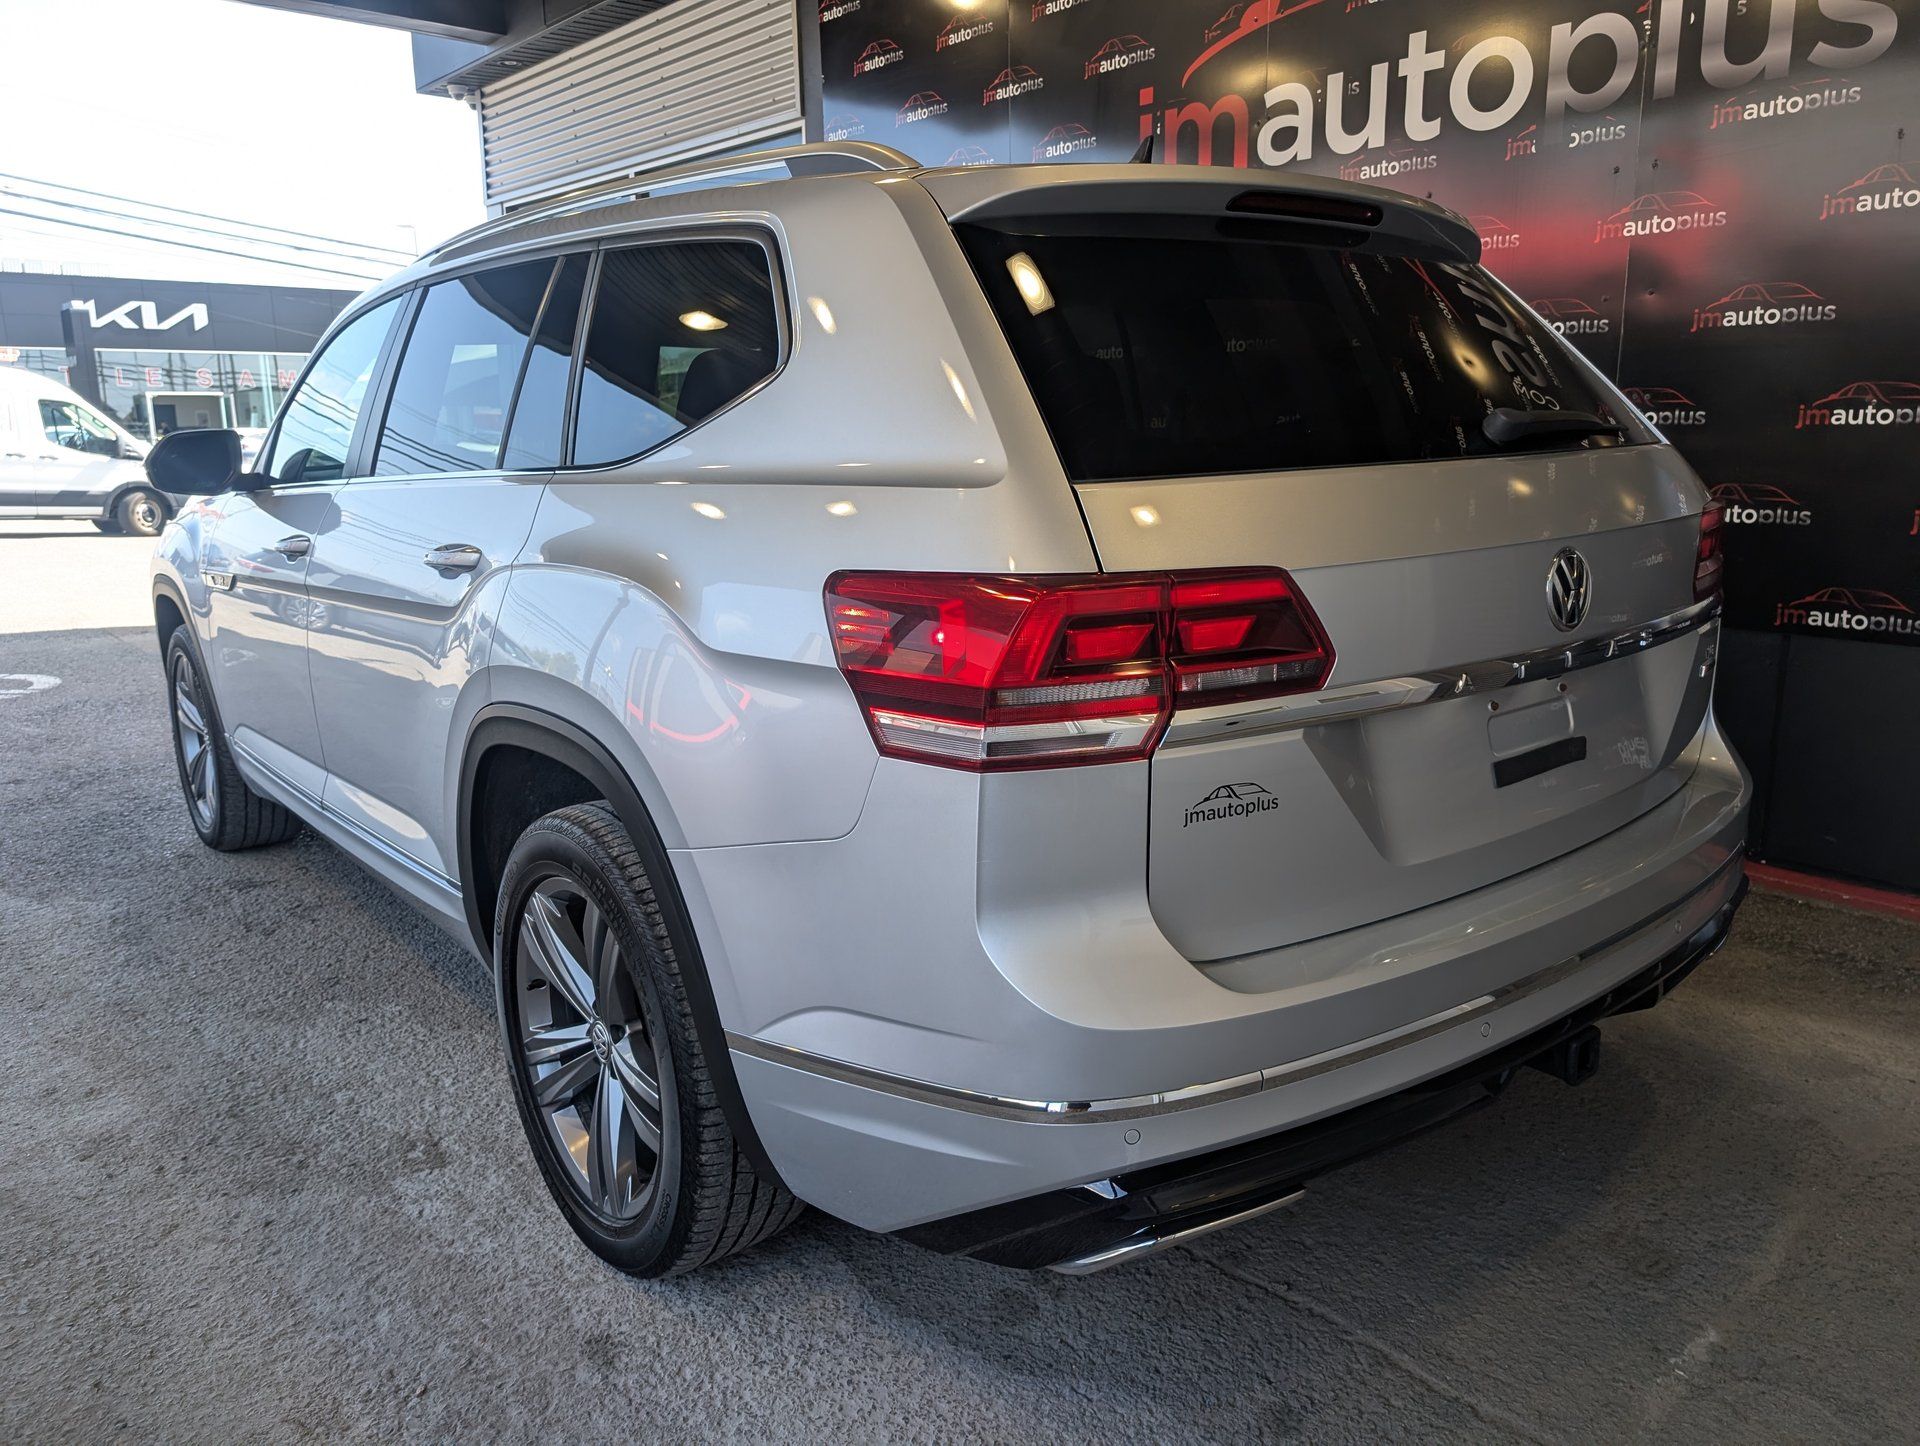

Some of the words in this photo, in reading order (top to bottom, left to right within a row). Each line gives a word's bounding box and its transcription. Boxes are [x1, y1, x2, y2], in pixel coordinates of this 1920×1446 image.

[936, 21, 994, 52] jmautoplus
[853, 49, 904, 78] jmautoplus
[1084, 48, 1156, 80] jmautoplus
[983, 77, 1044, 106] jmautoplus
[895, 102, 948, 128] jmautoplus
[1710, 86, 1861, 129] jmautoplus
[1032, 136, 1097, 163] jmautoplus
[1819, 188, 1920, 220] jmauto
[1592, 210, 1727, 243] jmautoplus
[82, 299, 209, 331] KIA
[1690, 302, 1836, 333] jmautoplus
[1183, 796, 1279, 828] jmautoplus
